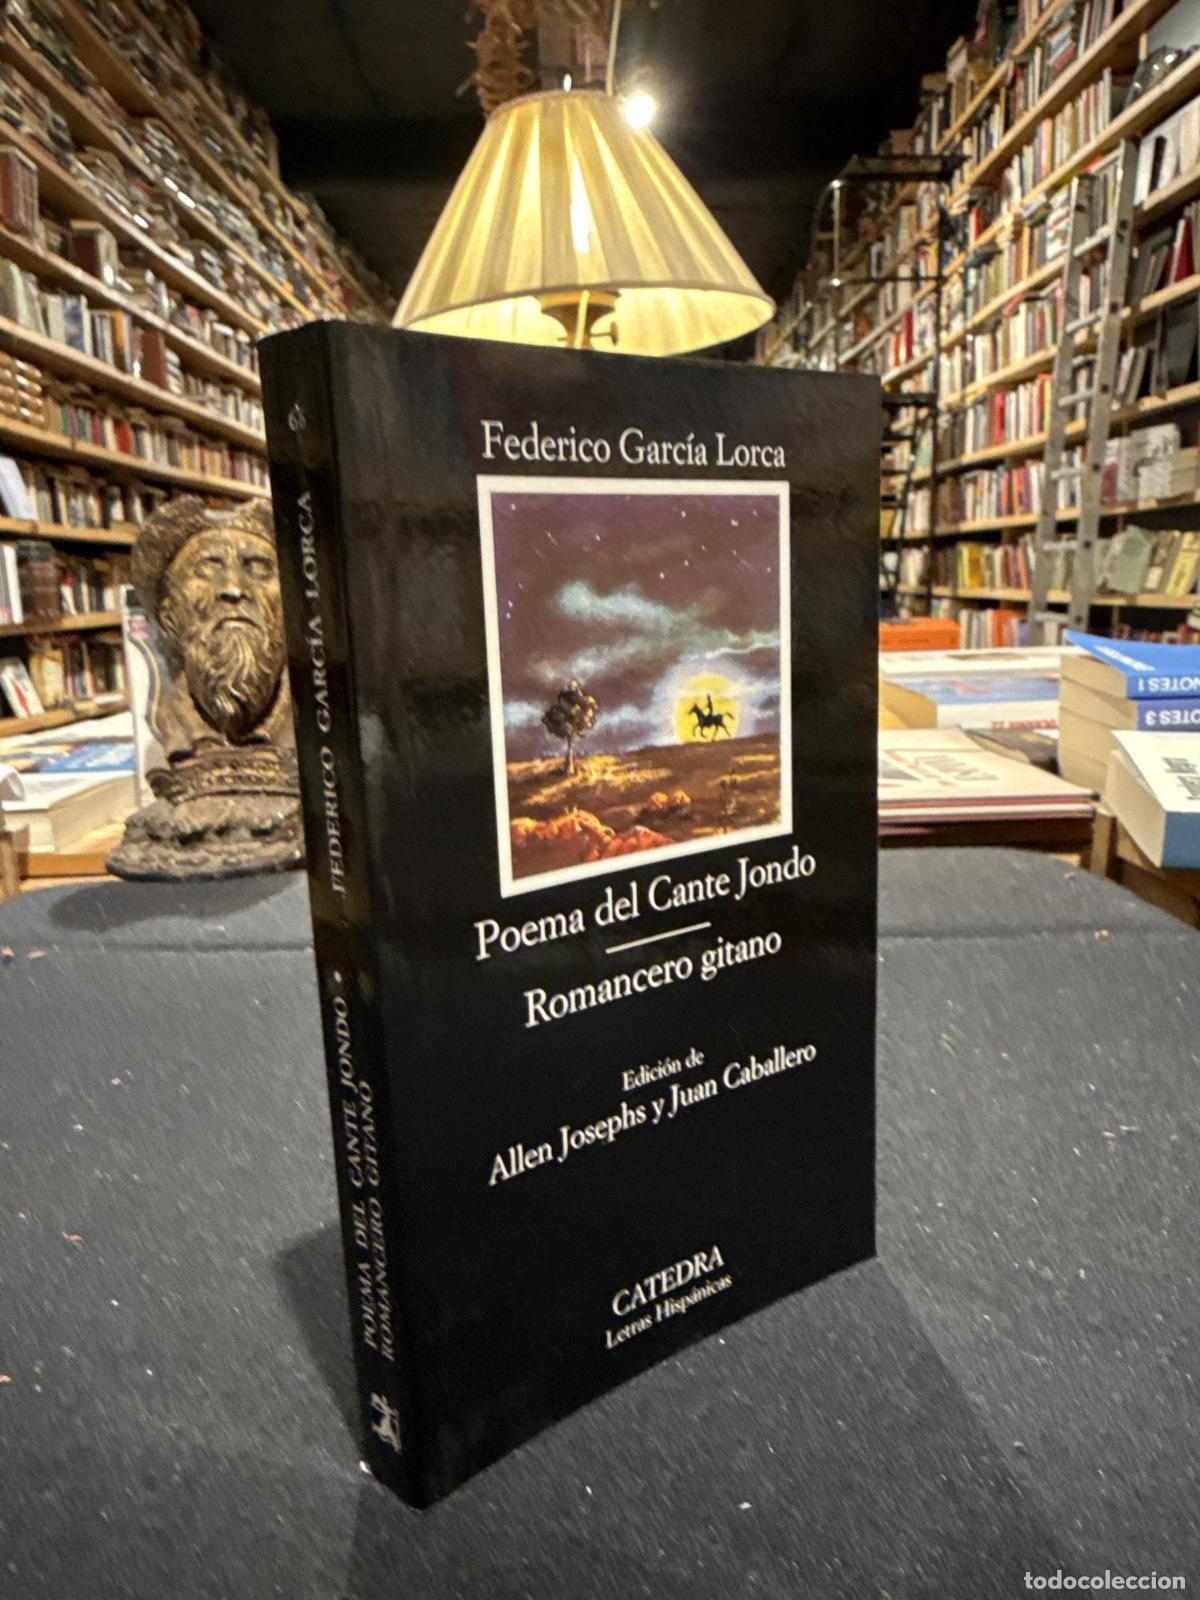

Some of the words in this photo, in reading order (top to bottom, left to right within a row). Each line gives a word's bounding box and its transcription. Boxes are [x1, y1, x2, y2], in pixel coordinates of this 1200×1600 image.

[480, 419, 611, 464] Federico
[618, 426, 709, 466] García
[715, 432, 787, 468] Lorca
[297, 490, 321, 599] LORCA
[1137, 676, 1146, 692] 1
[1144, 709, 1157, 727] 3
[319, 744, 349, 897] FEDERICO
[473, 908, 586, 962] Poema
[594, 880, 641, 928] del
[648, 871, 731, 912] Cante
[733, 844, 817, 901] Jondo
[523, 955, 694, 1030] Romancero
[700, 931, 783, 982] gitano
[334, 995, 360, 1095] JONDO
[622, 1055, 683, 1092] Edición
[685, 1046, 706, 1068] de
[343, 1099, 364, 1188] CANTE
[358, 1079, 382, 1187] GITANO
[488, 1142, 554, 1187] Allen
[557, 1101, 648, 1163] Josephs
[651, 1096, 667, 1125] y
[667, 1078, 719, 1119] Juan
[723, 1043, 818, 1091] Caballero
[352, 1199, 369, 1250] DEL
[358, 1262, 378, 1349] POEMA
[369, 1197, 396, 1362] ROMANCERO
[605, 1313, 653, 1350] Letras
[654, 1273, 734, 1323] Hispánicas
[611, 1244, 726, 1317] CATEDRA
